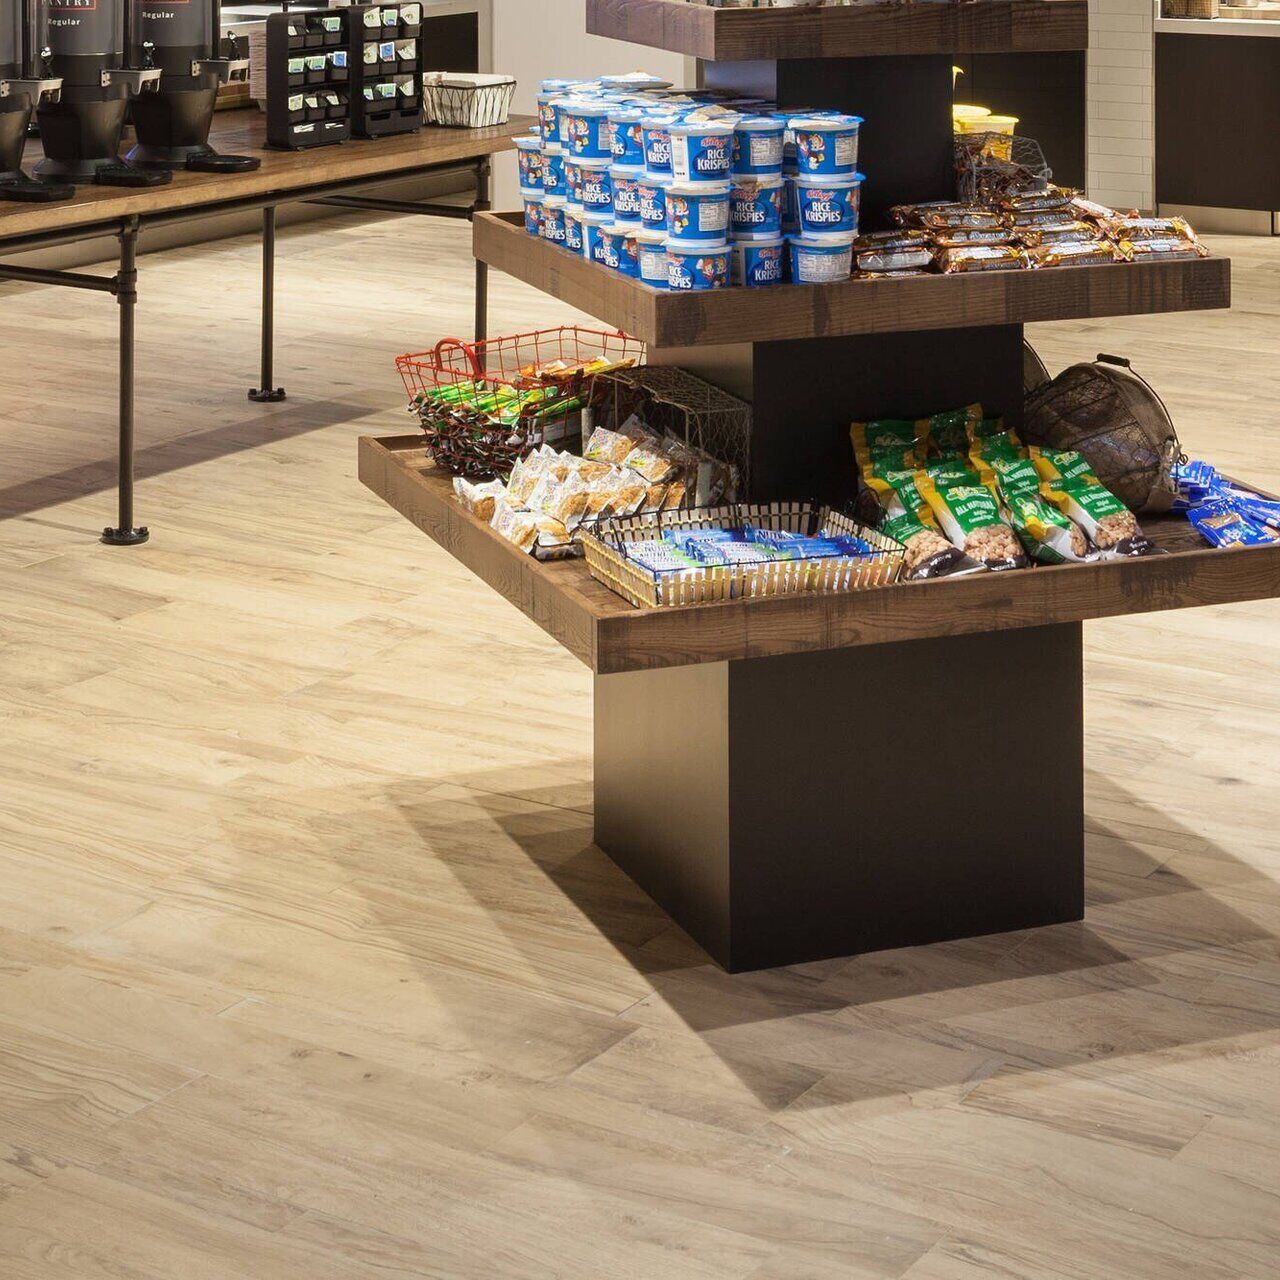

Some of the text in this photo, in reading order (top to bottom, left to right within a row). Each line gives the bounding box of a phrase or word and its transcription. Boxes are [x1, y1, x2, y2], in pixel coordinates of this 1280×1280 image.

[142, 11, 174, 19] Regular
[48, 18, 80, 27] Regular
[707, 149, 724, 159] RICE
[698, 158, 730, 170] KRISPIES
[586, 183, 601, 192] RICE
[619, 191, 635, 201] RICE
[736, 202, 755, 212] RICE
[812, 202, 830, 212] RICE
[730, 212, 764, 222] KRISPIES
[805, 210, 841, 222] KRISPIES
